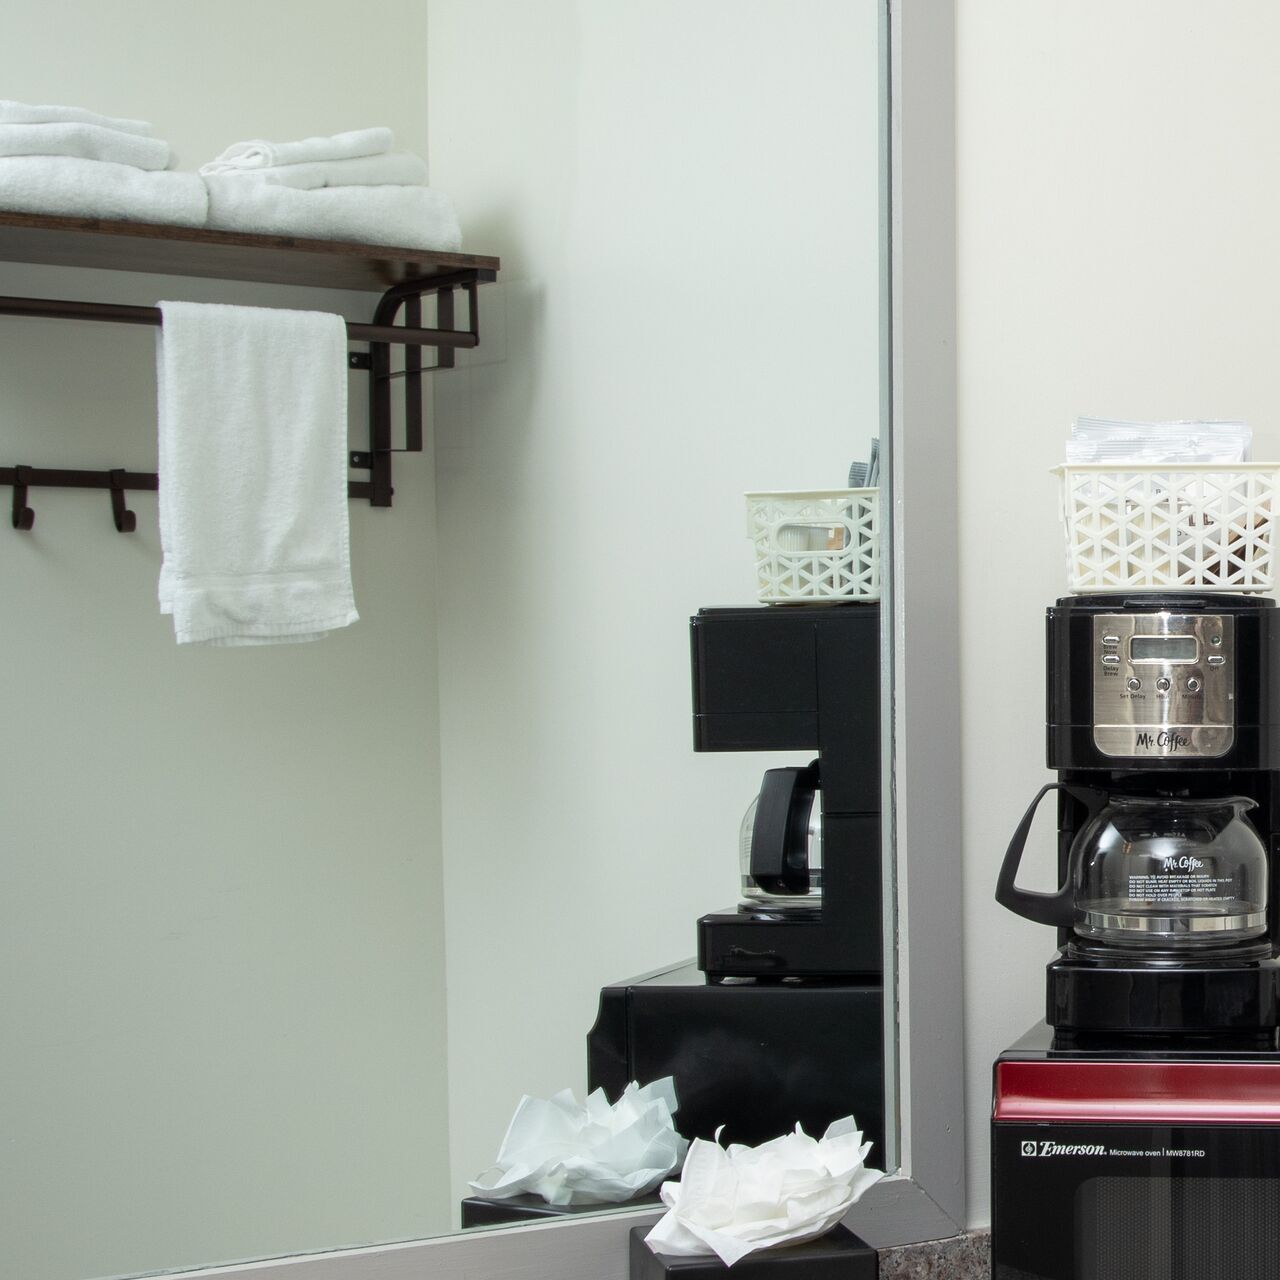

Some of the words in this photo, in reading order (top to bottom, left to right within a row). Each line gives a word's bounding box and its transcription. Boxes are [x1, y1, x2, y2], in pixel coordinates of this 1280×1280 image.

[1136, 732, 1155, 750] Mr.
[1157, 731, 1191, 752] Coffee
[1164, 857, 1178, 870] Mr.
[1179, 856, 1204, 872] Coffee
